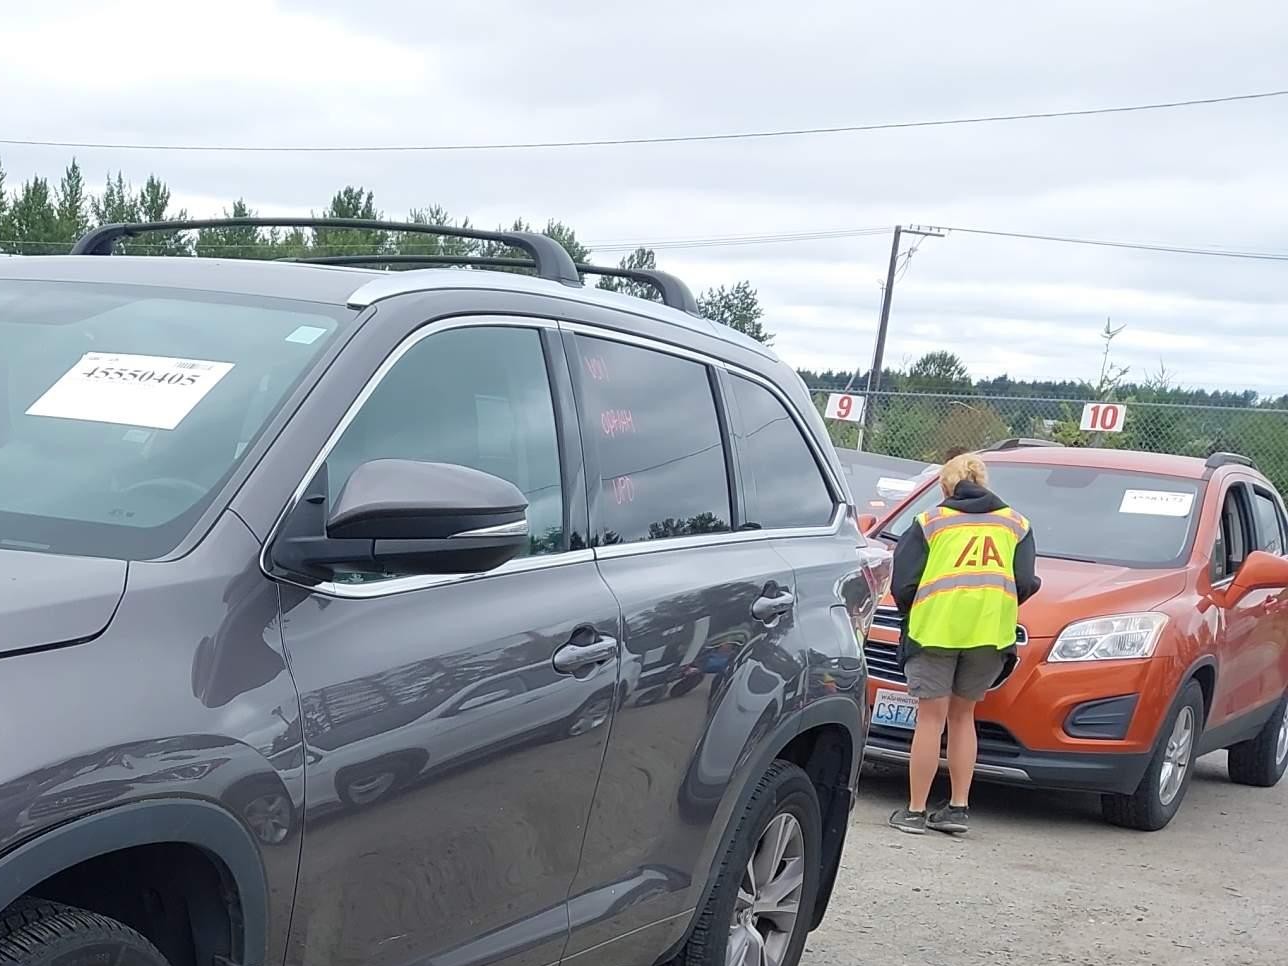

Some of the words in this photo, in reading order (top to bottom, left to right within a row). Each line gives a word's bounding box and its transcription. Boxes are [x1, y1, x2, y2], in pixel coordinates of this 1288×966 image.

[82, 366, 201, 386] 45550405
[836, 395, 852, 419] 9
[1088, 404, 1120, 430] 10
